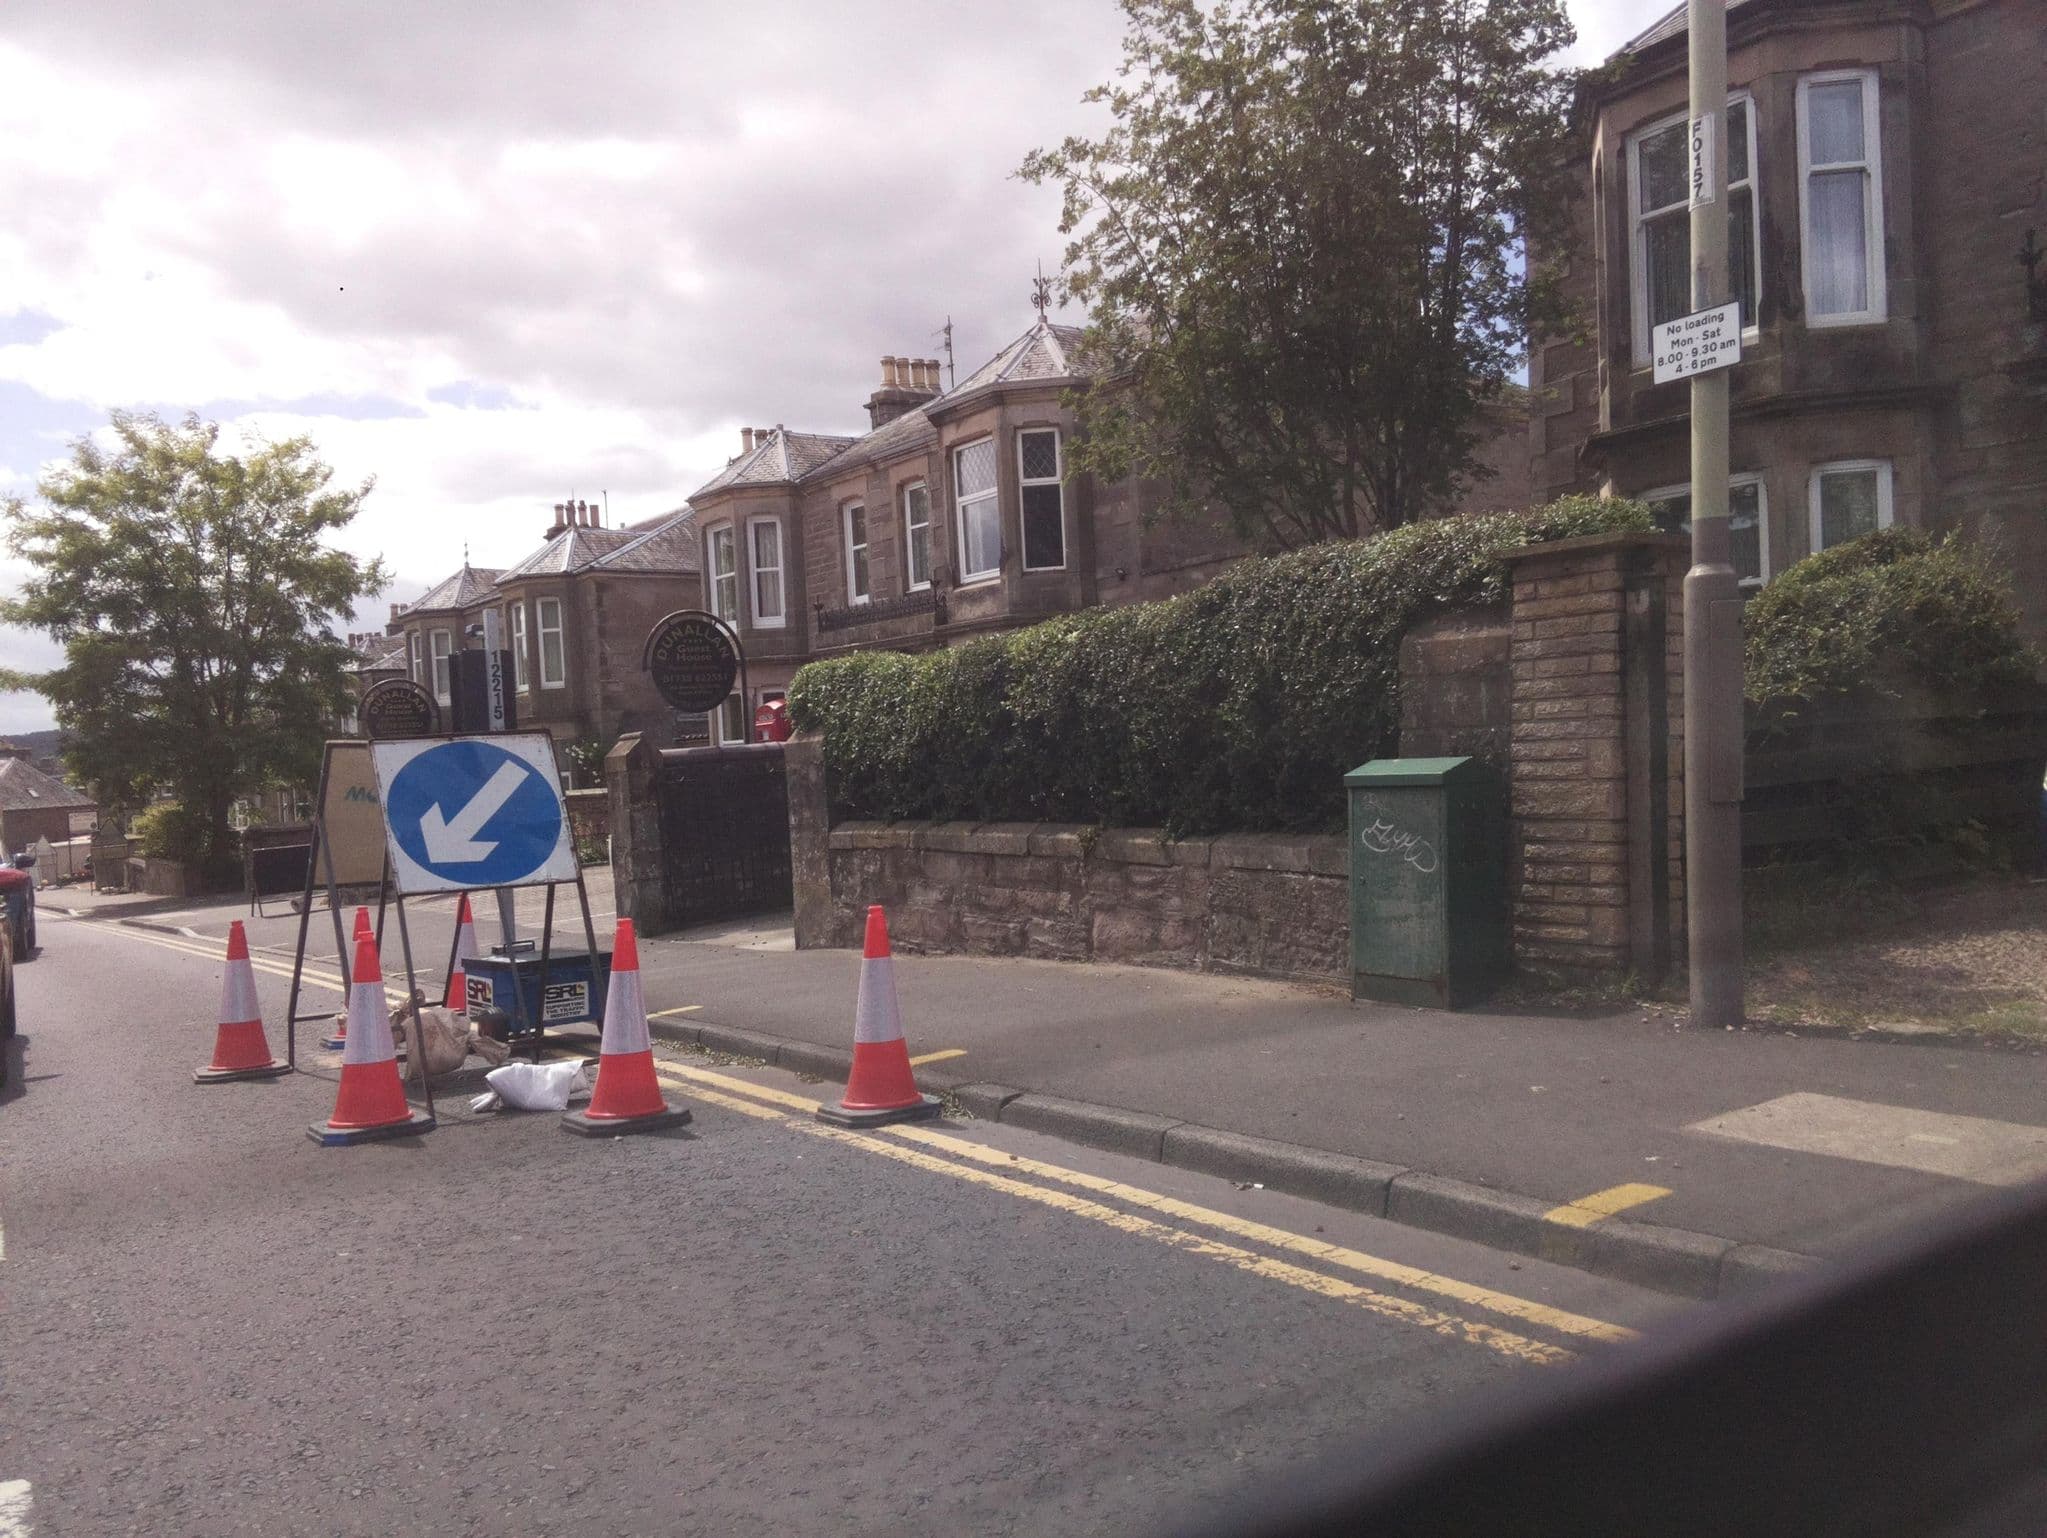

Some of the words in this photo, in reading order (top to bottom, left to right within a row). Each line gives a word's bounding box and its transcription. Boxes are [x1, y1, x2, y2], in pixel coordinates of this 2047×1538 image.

[1692, 120, 1703, 198] F0157
[1667, 325, 1682, 336] No
[1685, 312, 1724, 330] loading
[1671, 337, 1694, 350] Mon
[1702, 327, 1721, 341] Sat
[1658, 352, 1683, 367] 8.00
[1691, 342, 1717, 358] 9.30
[1720, 339, 1736, 350] am
[1701, 356, 1717, 369] pm
[657, 624, 729, 660] DUNALLAN
[677, 644, 712, 653] Guest
[677, 653, 713, 662] House
[491, 651, 503, 720] 12215
[468, 979, 491, 1003] SRL
[546, 984, 584, 1000] SRL
